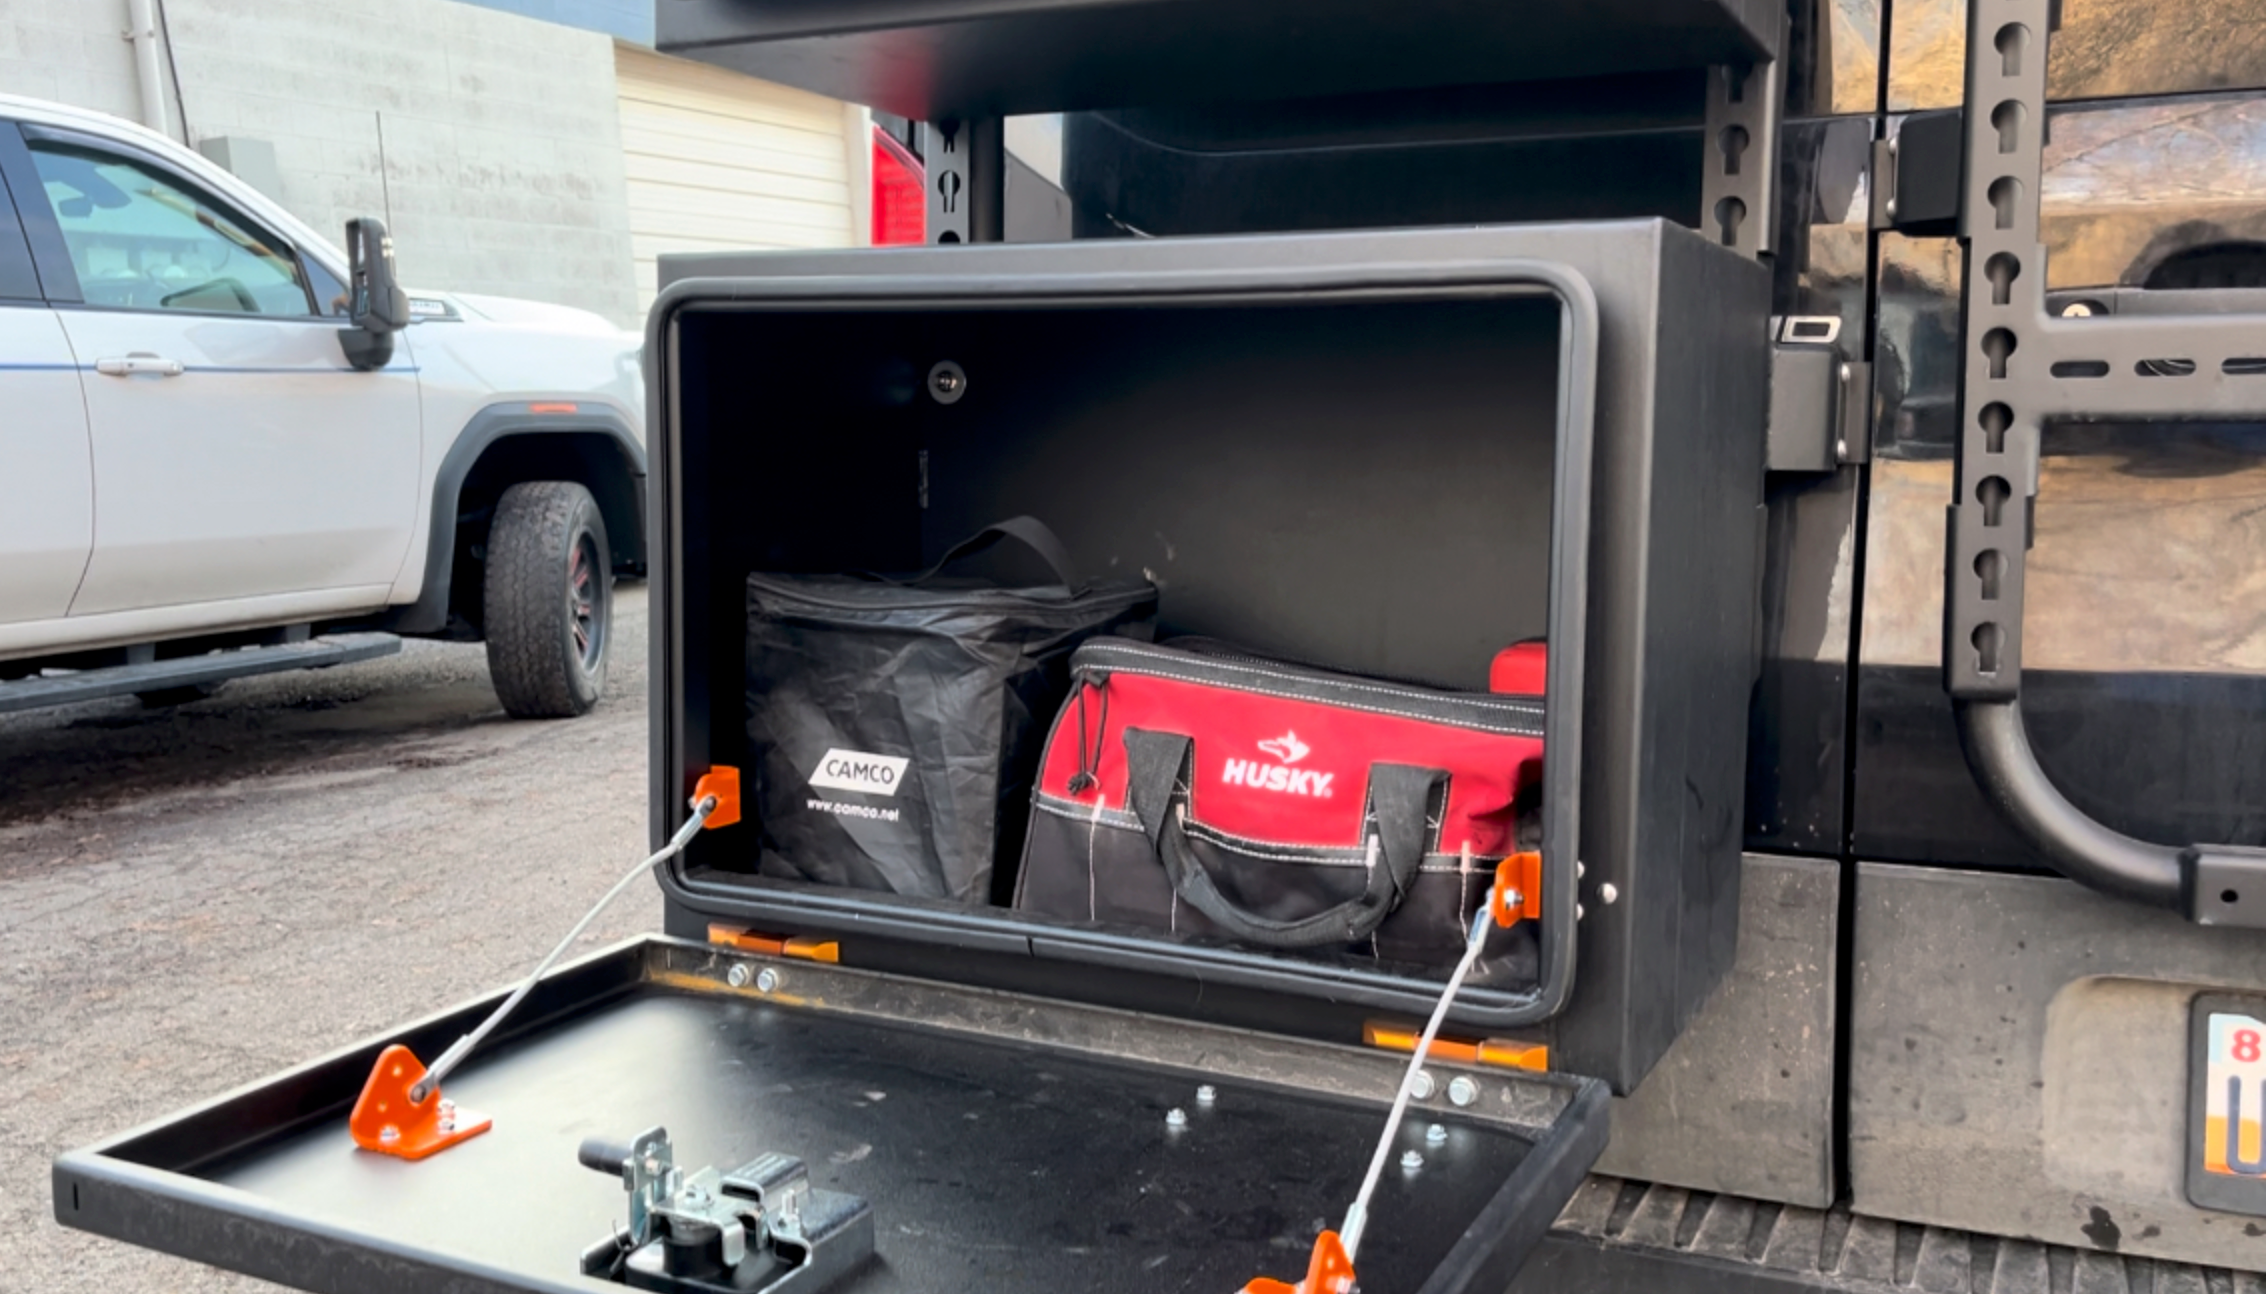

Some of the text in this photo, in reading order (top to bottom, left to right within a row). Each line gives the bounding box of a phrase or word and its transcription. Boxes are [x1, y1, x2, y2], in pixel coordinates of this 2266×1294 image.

[826, 759, 895, 784] CAMCO
[1222, 757, 1334, 797] HUSKY
[2231, 1029, 2261, 1062] 8
